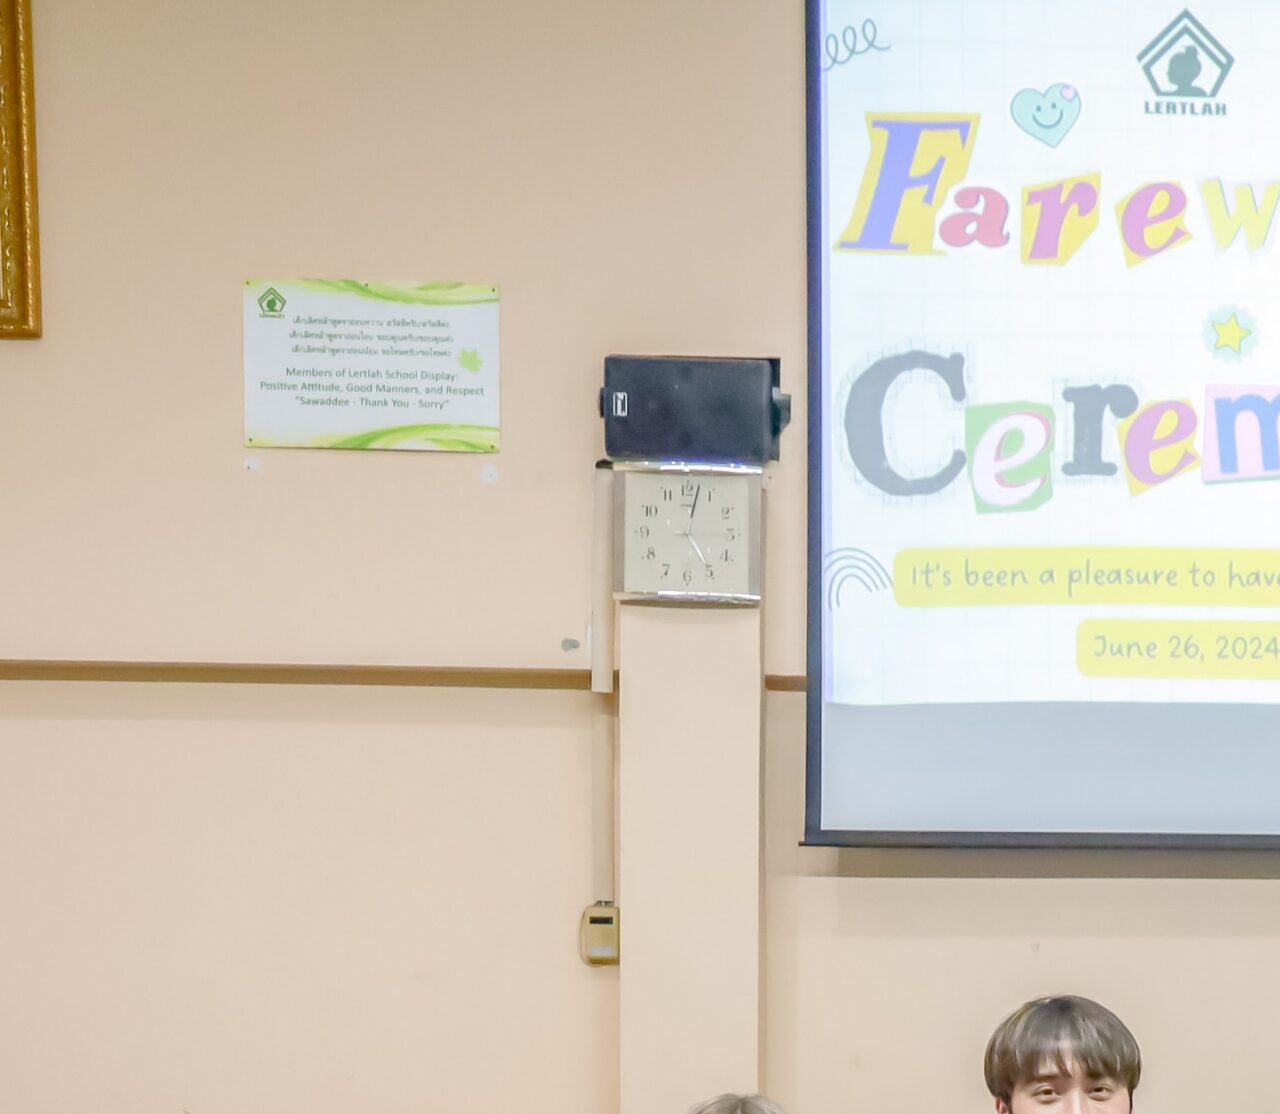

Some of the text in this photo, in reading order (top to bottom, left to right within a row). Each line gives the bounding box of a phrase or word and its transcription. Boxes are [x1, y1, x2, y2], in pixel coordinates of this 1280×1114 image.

[1144, 100, 1227, 116] LERTLAH
[286, 367, 333, 377] Members
[335, 368, 346, 377] of
[348, 369, 382, 378] Lertlah
[385, 370, 418, 380] School
[260, 381, 484, 396] Positive Attitude, Good Manners, and Respect
[360, 397, 388, 407] Thank
[391, 399, 409, 408] You
[912, 564, 952, 587] It's
[964, 563, 1028, 587] been
[1040, 568, 1056, 586] a
[1068, 561, 1178, 597] pleasure
[1191, 564, 1216, 588] to
[1094, 635, 1280, 661] June 26, 2024
